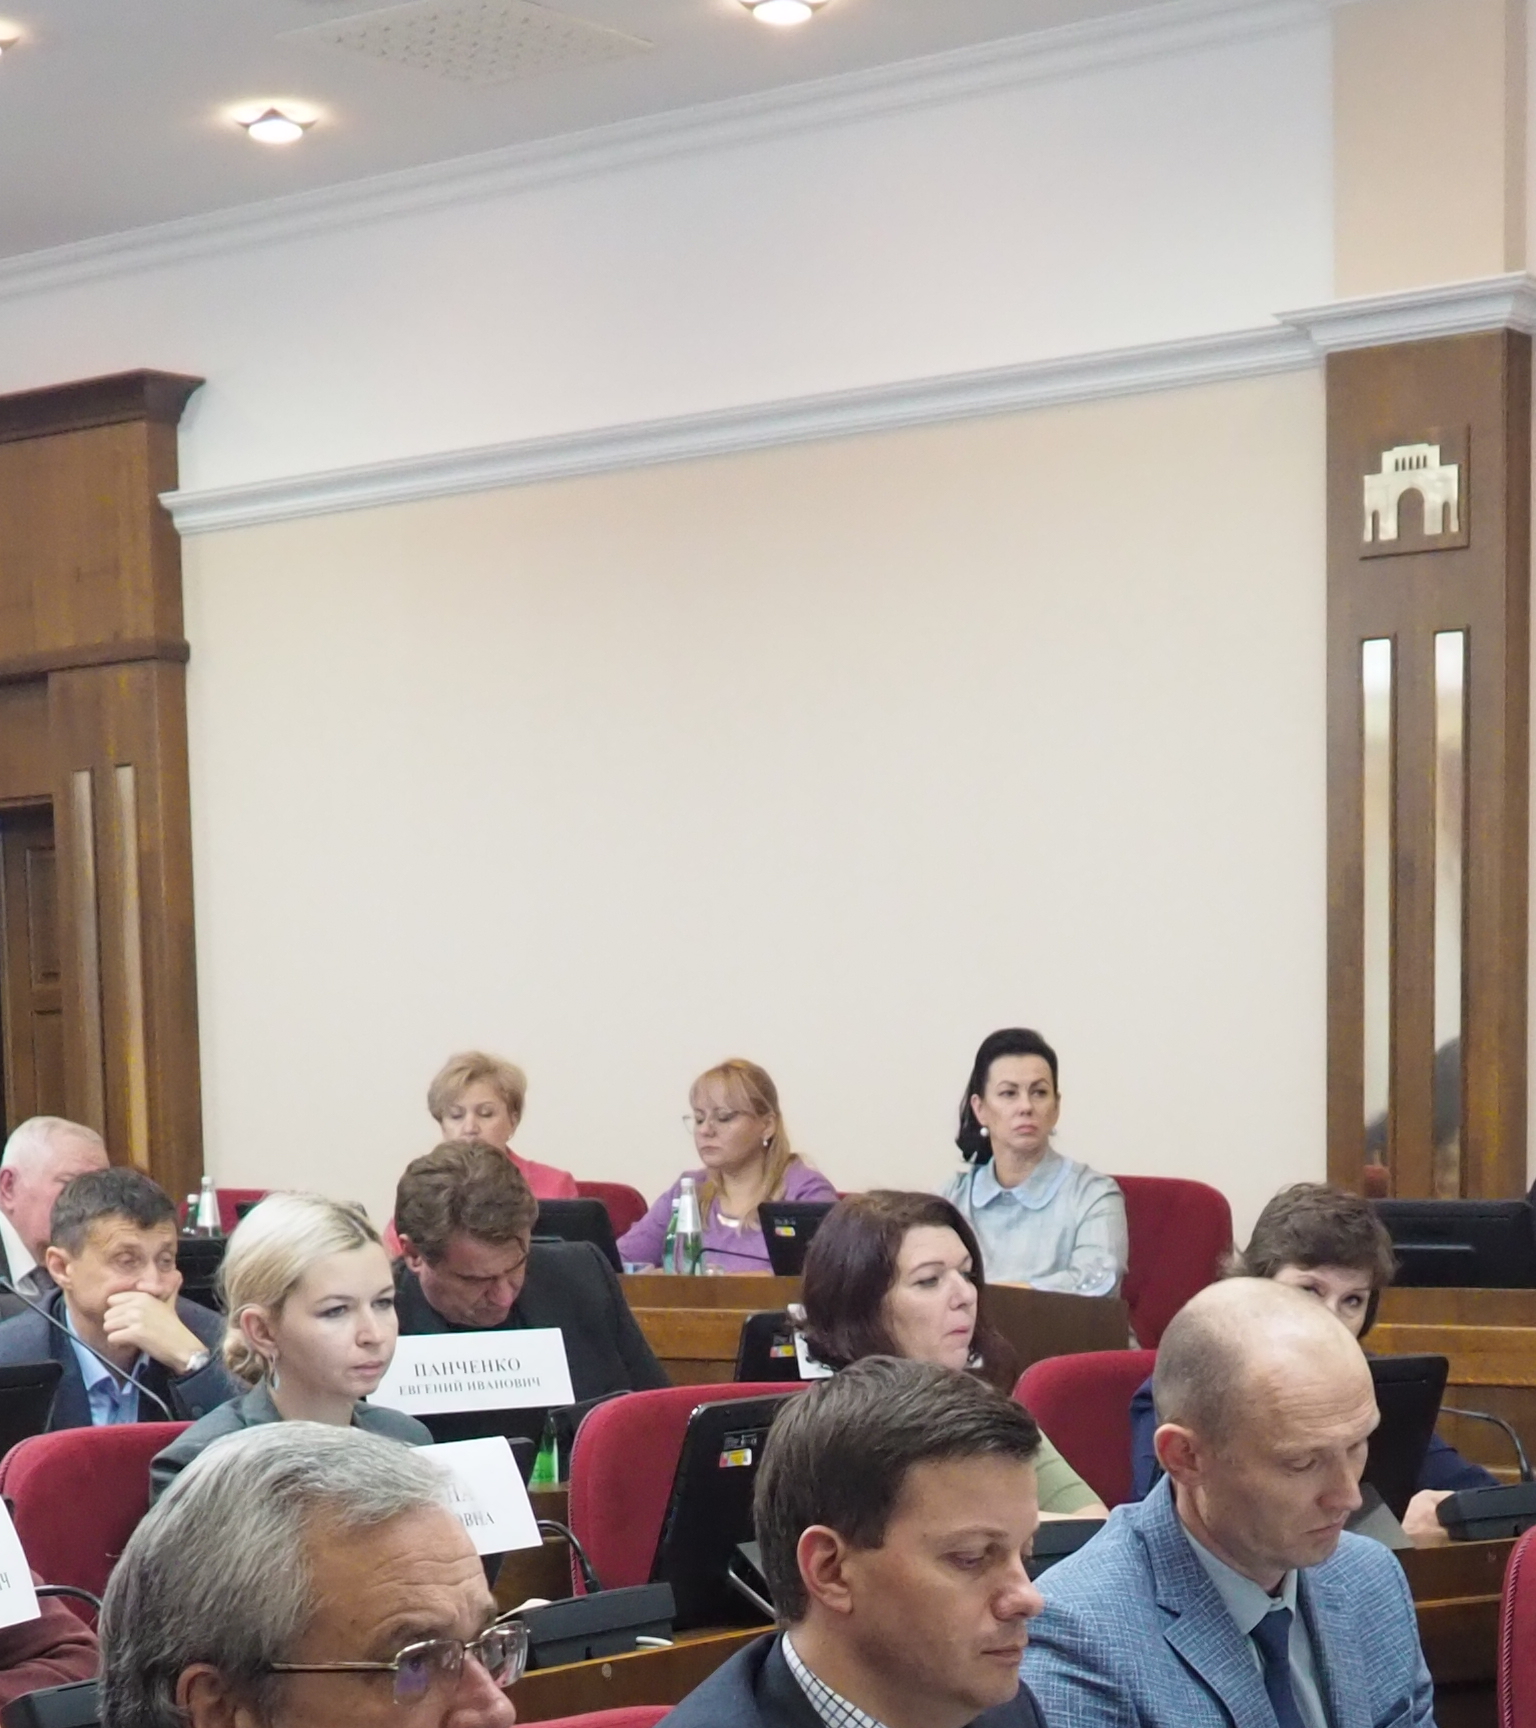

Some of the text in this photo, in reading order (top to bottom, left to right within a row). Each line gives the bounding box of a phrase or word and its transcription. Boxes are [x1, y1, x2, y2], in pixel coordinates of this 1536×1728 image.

[413, 1357, 522, 1378] ПАНЧЕНКО
[398, 1376, 542, 1397] ЕВГЕНИЙ ИВАНОВИЧ
